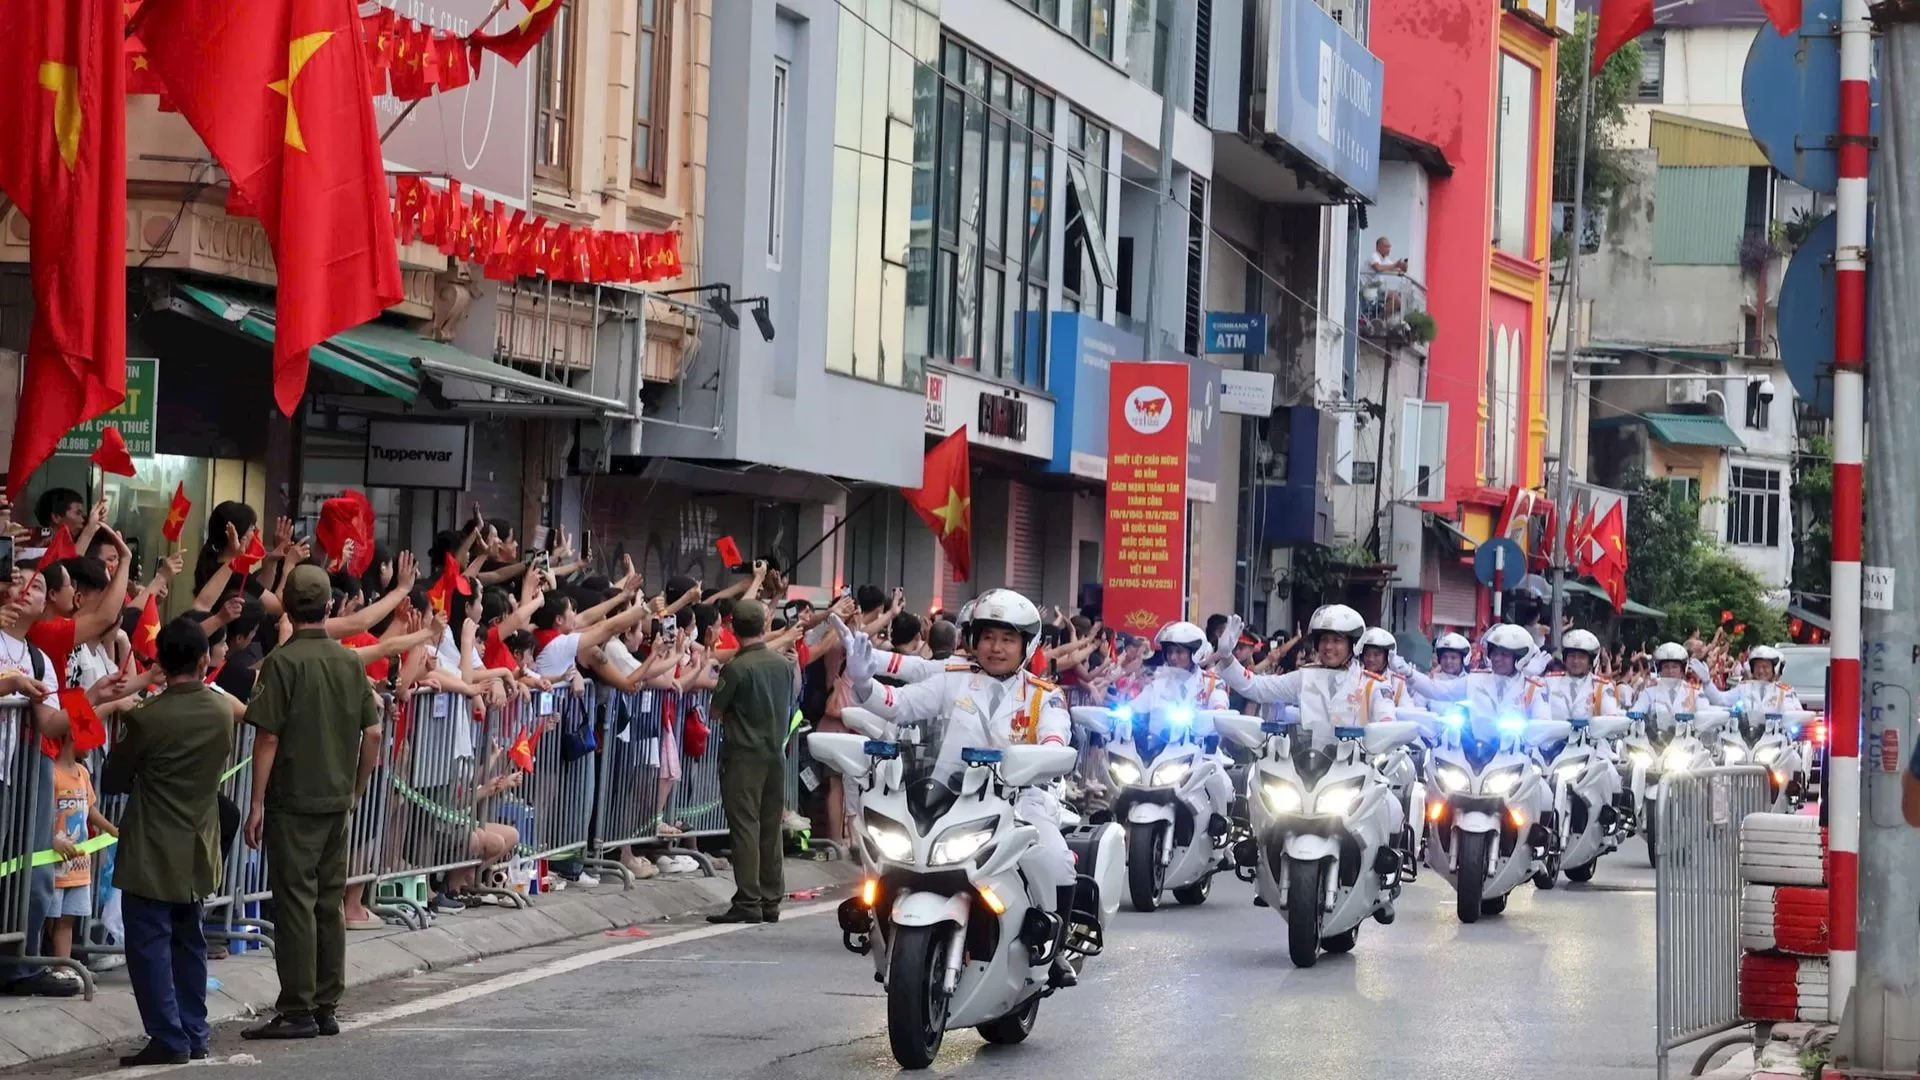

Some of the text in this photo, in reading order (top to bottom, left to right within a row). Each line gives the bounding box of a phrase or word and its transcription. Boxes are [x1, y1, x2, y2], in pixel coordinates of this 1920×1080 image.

[1216, 333, 1247, 348] ATM
[126, 366, 140, 379] IN
[122, 419, 150, 434] THUÊ
[371, 446, 453, 462] Tupperwar
